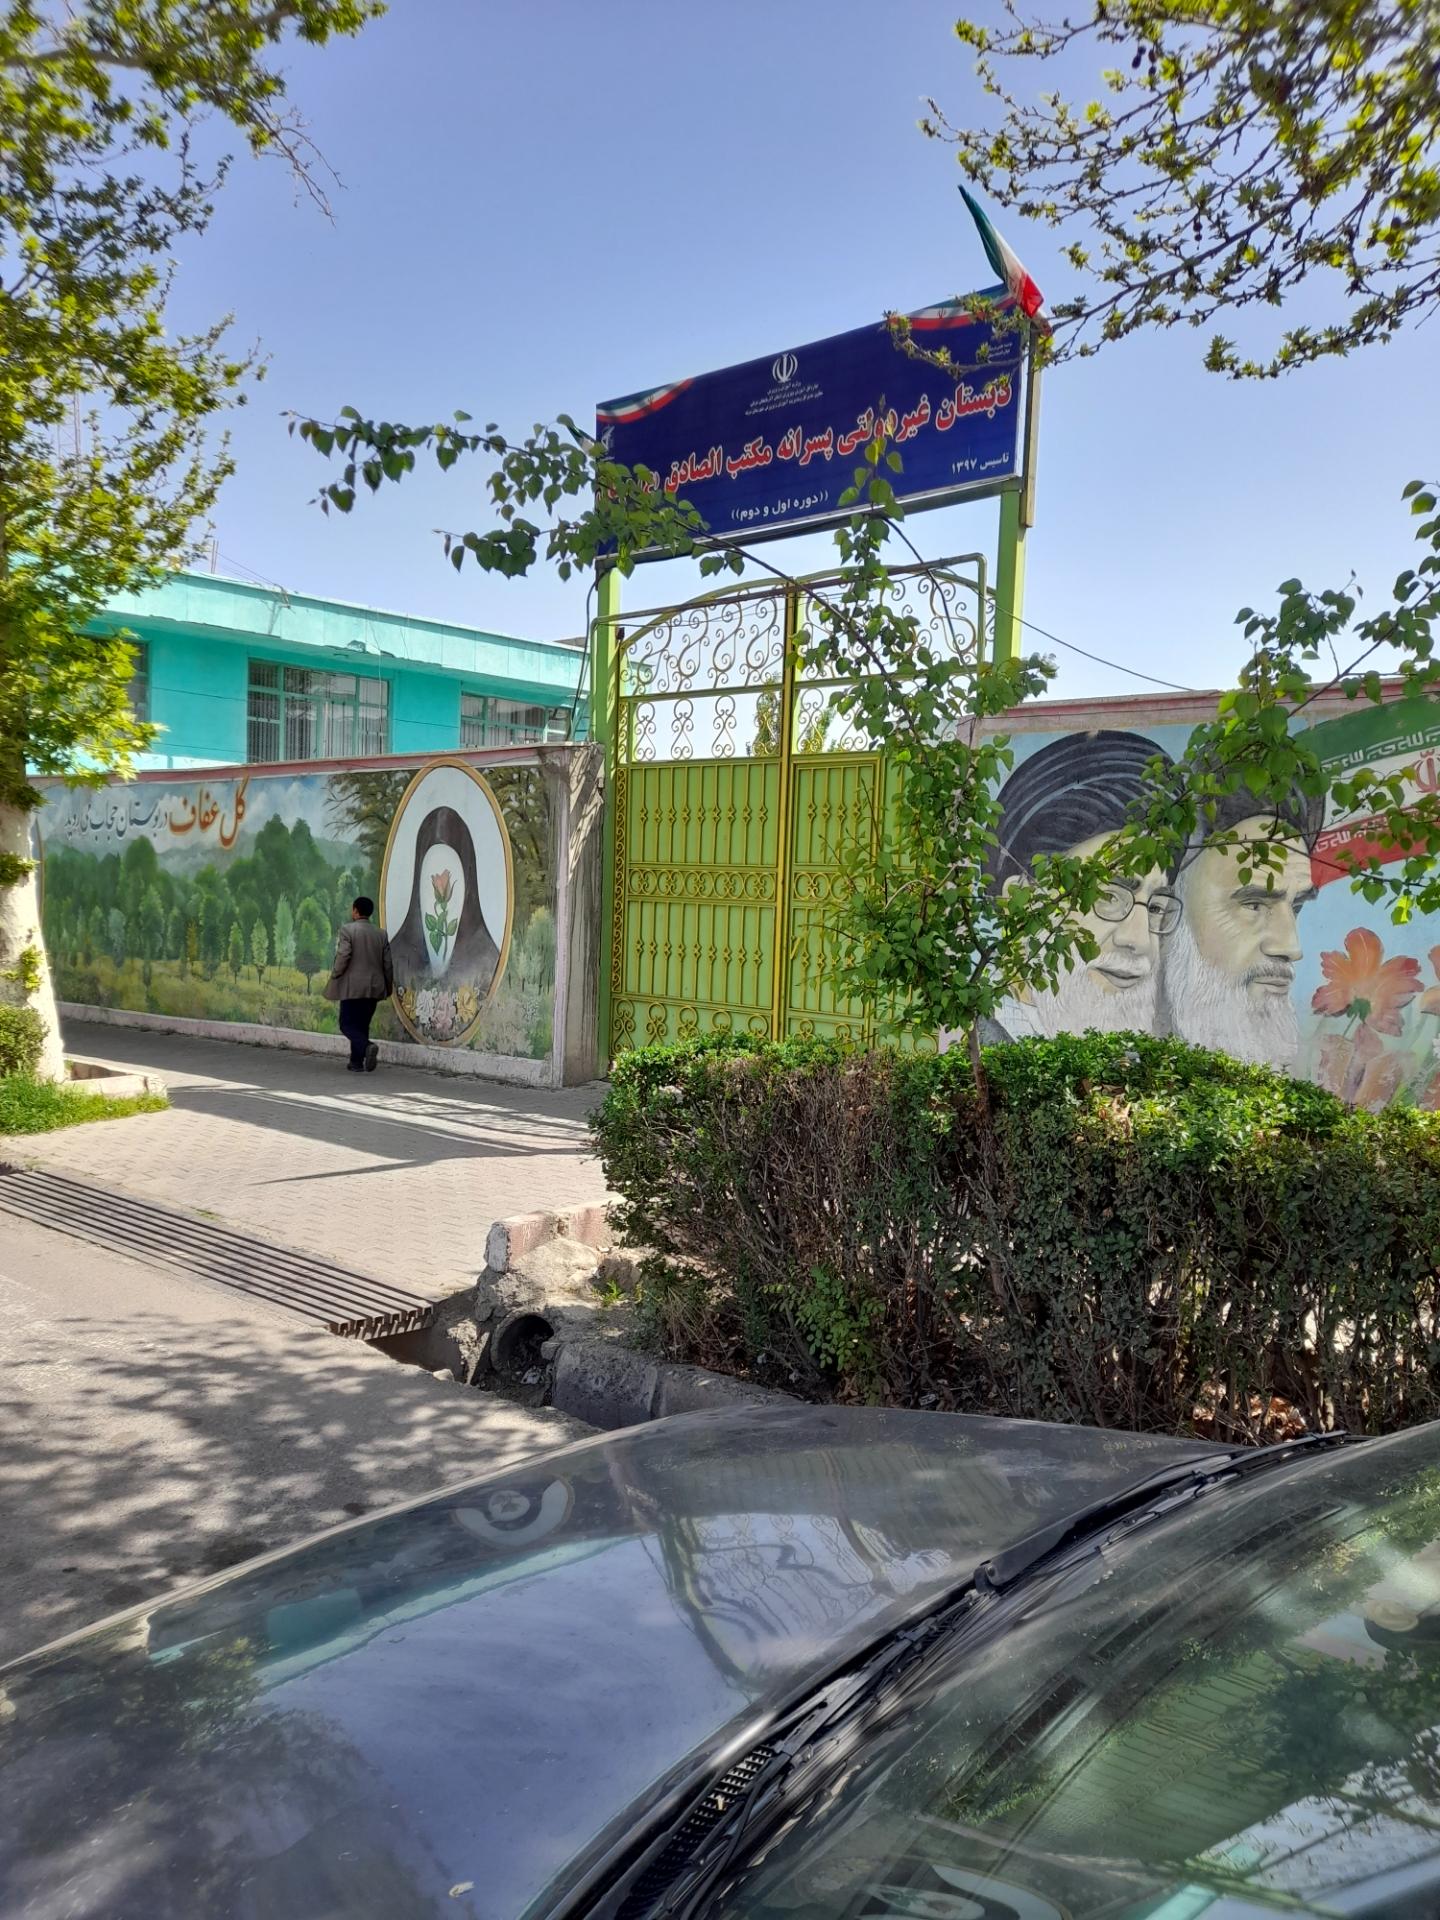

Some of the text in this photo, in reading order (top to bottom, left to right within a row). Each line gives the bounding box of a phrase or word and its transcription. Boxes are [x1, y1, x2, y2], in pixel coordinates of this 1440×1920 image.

[935, 379, 1012, 431] دبستان
[726, 435, 773, 480] مکتب
[776, 425, 834, 466] پسرانه
[951, 457, 978, 475] ۱۳۹۷
[664, 444, 723, 494] الصادق
[762, 505, 770, 517] و
[771, 498, 791, 516] اول
[168, 786, 221, 836] عفاف
[218, 770, 249, 849] گل
